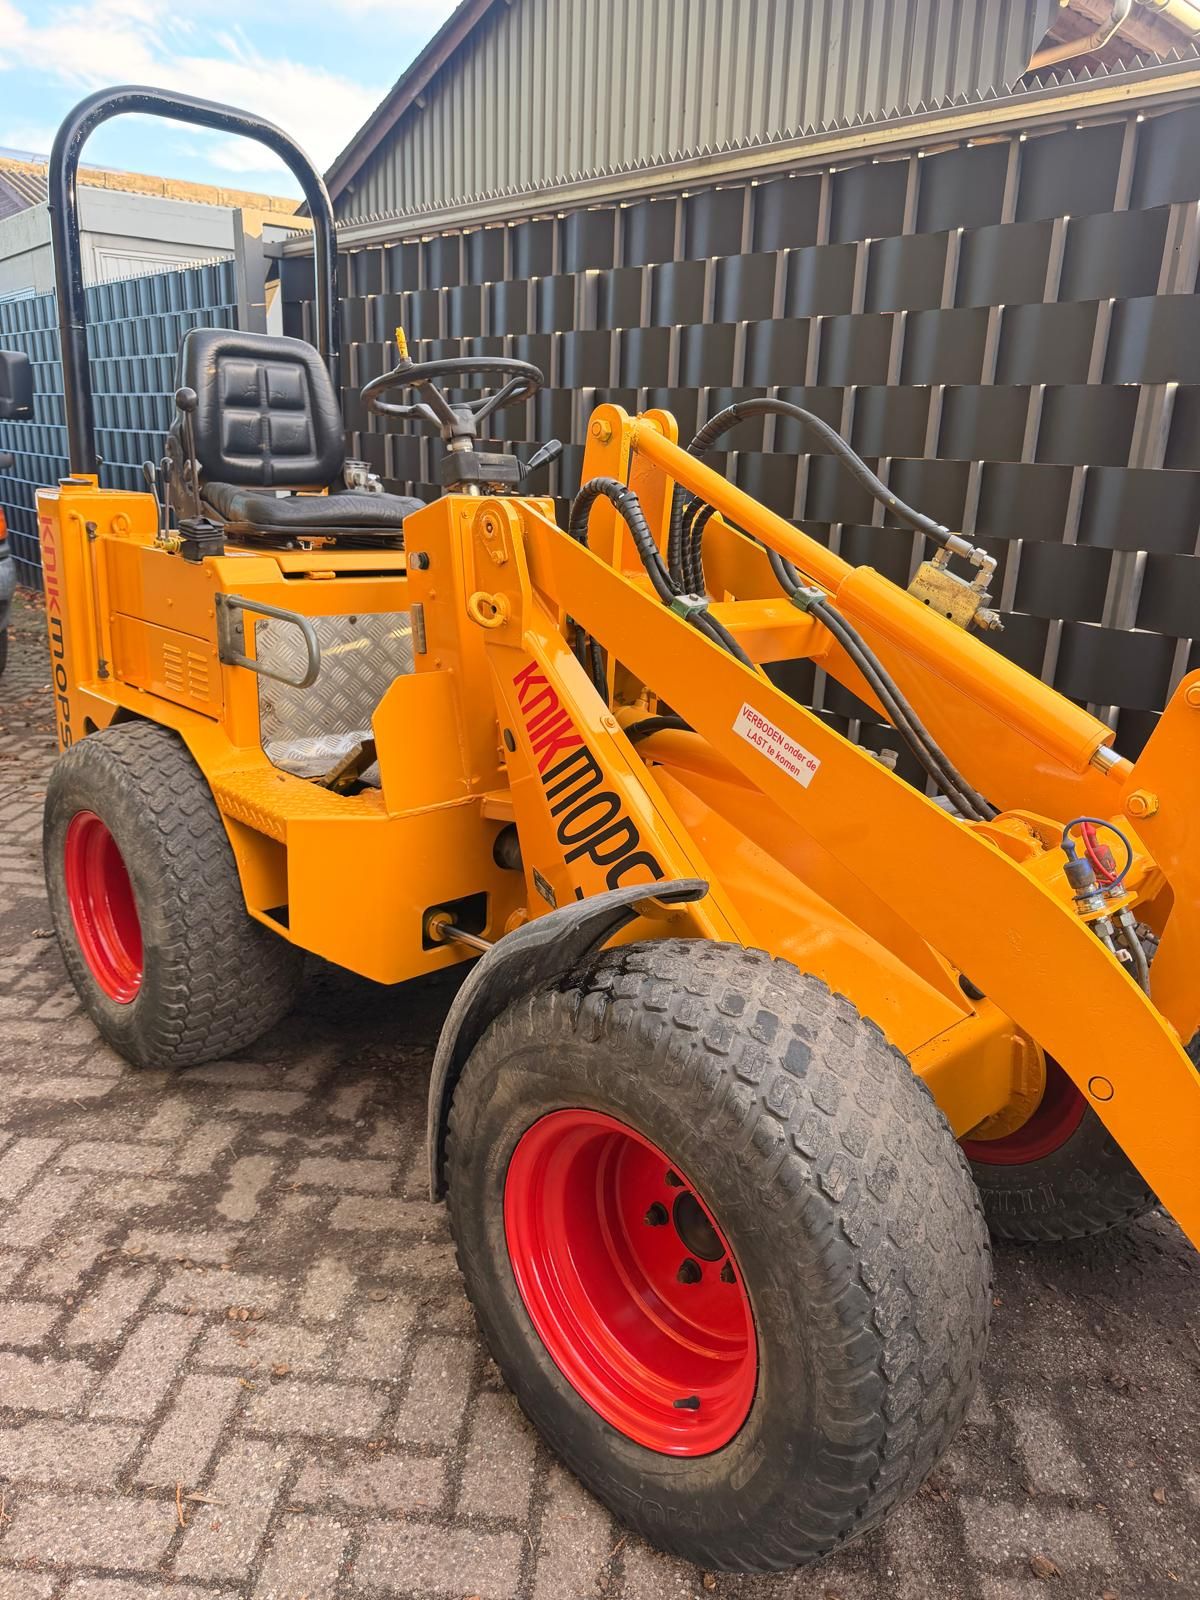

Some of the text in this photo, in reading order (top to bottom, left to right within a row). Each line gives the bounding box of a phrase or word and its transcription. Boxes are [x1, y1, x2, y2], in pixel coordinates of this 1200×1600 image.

[742, 706, 817, 772] VERBODEN onder de
[746, 728, 801, 777] LAST te komen
